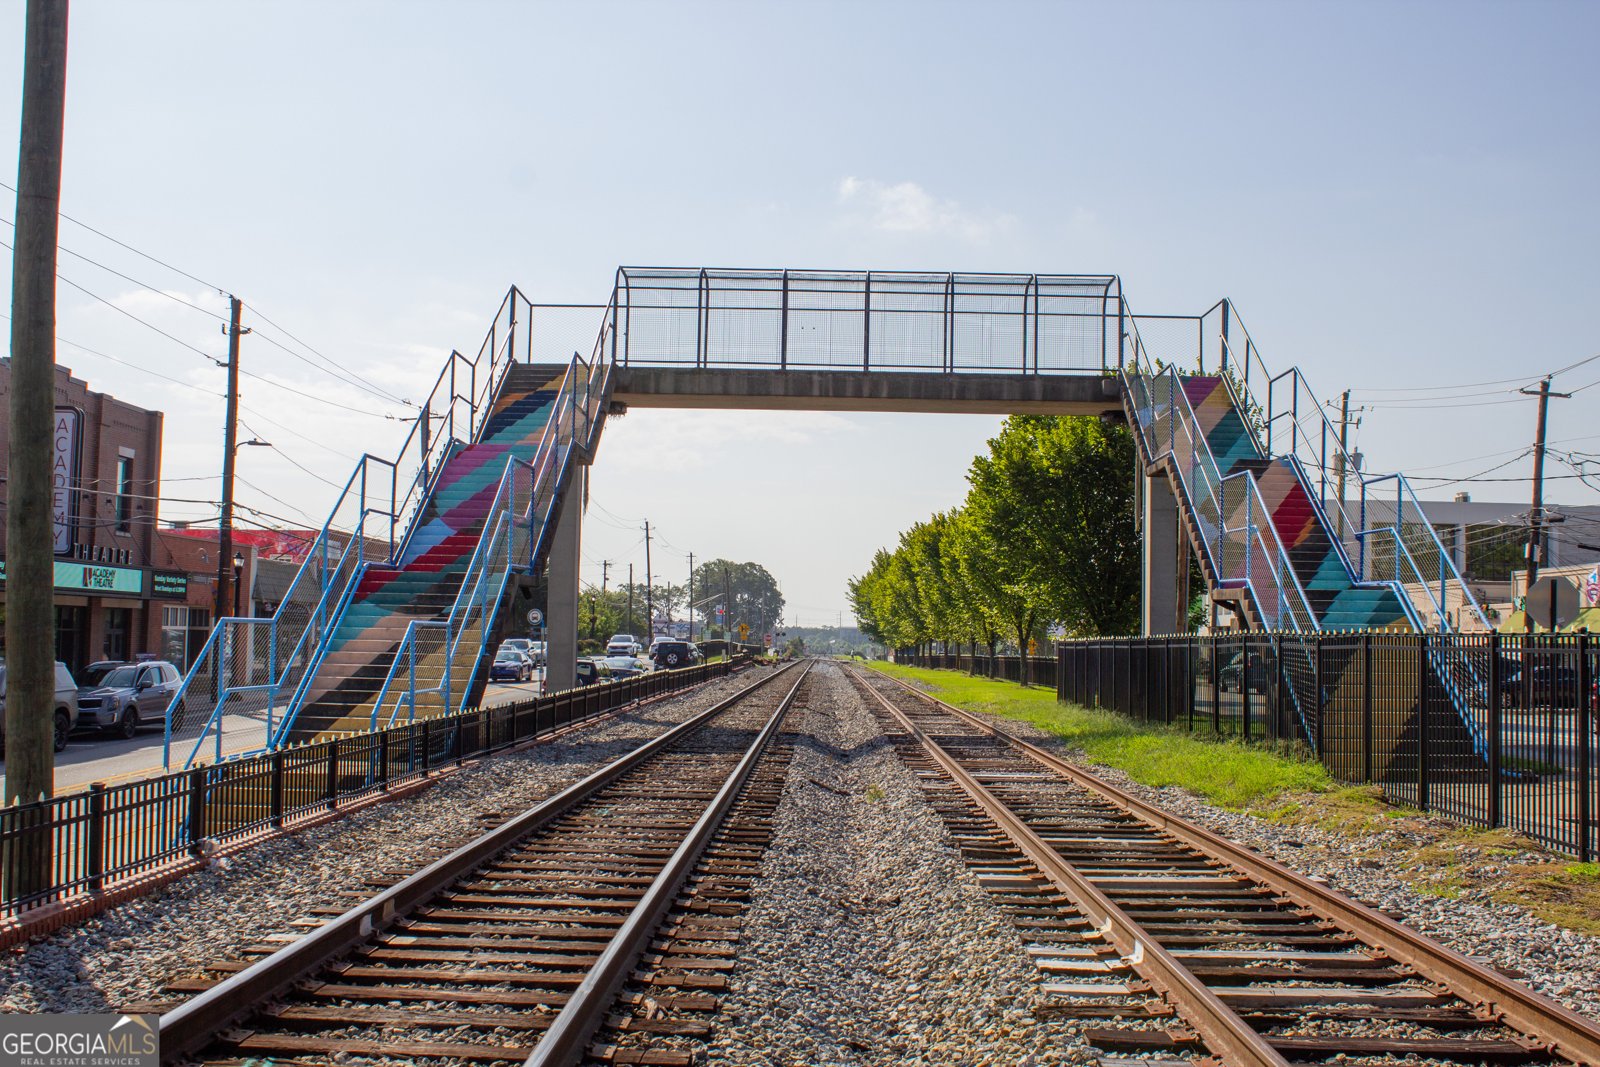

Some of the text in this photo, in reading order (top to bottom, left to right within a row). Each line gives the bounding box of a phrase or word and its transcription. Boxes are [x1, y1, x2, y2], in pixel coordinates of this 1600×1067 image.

[53, 418, 69, 545] ACADEMY
[74, 542, 133, 565] THEATRE
[92, 568, 117, 579] ACADEMY
[93, 577, 114, 589] THEATRE
